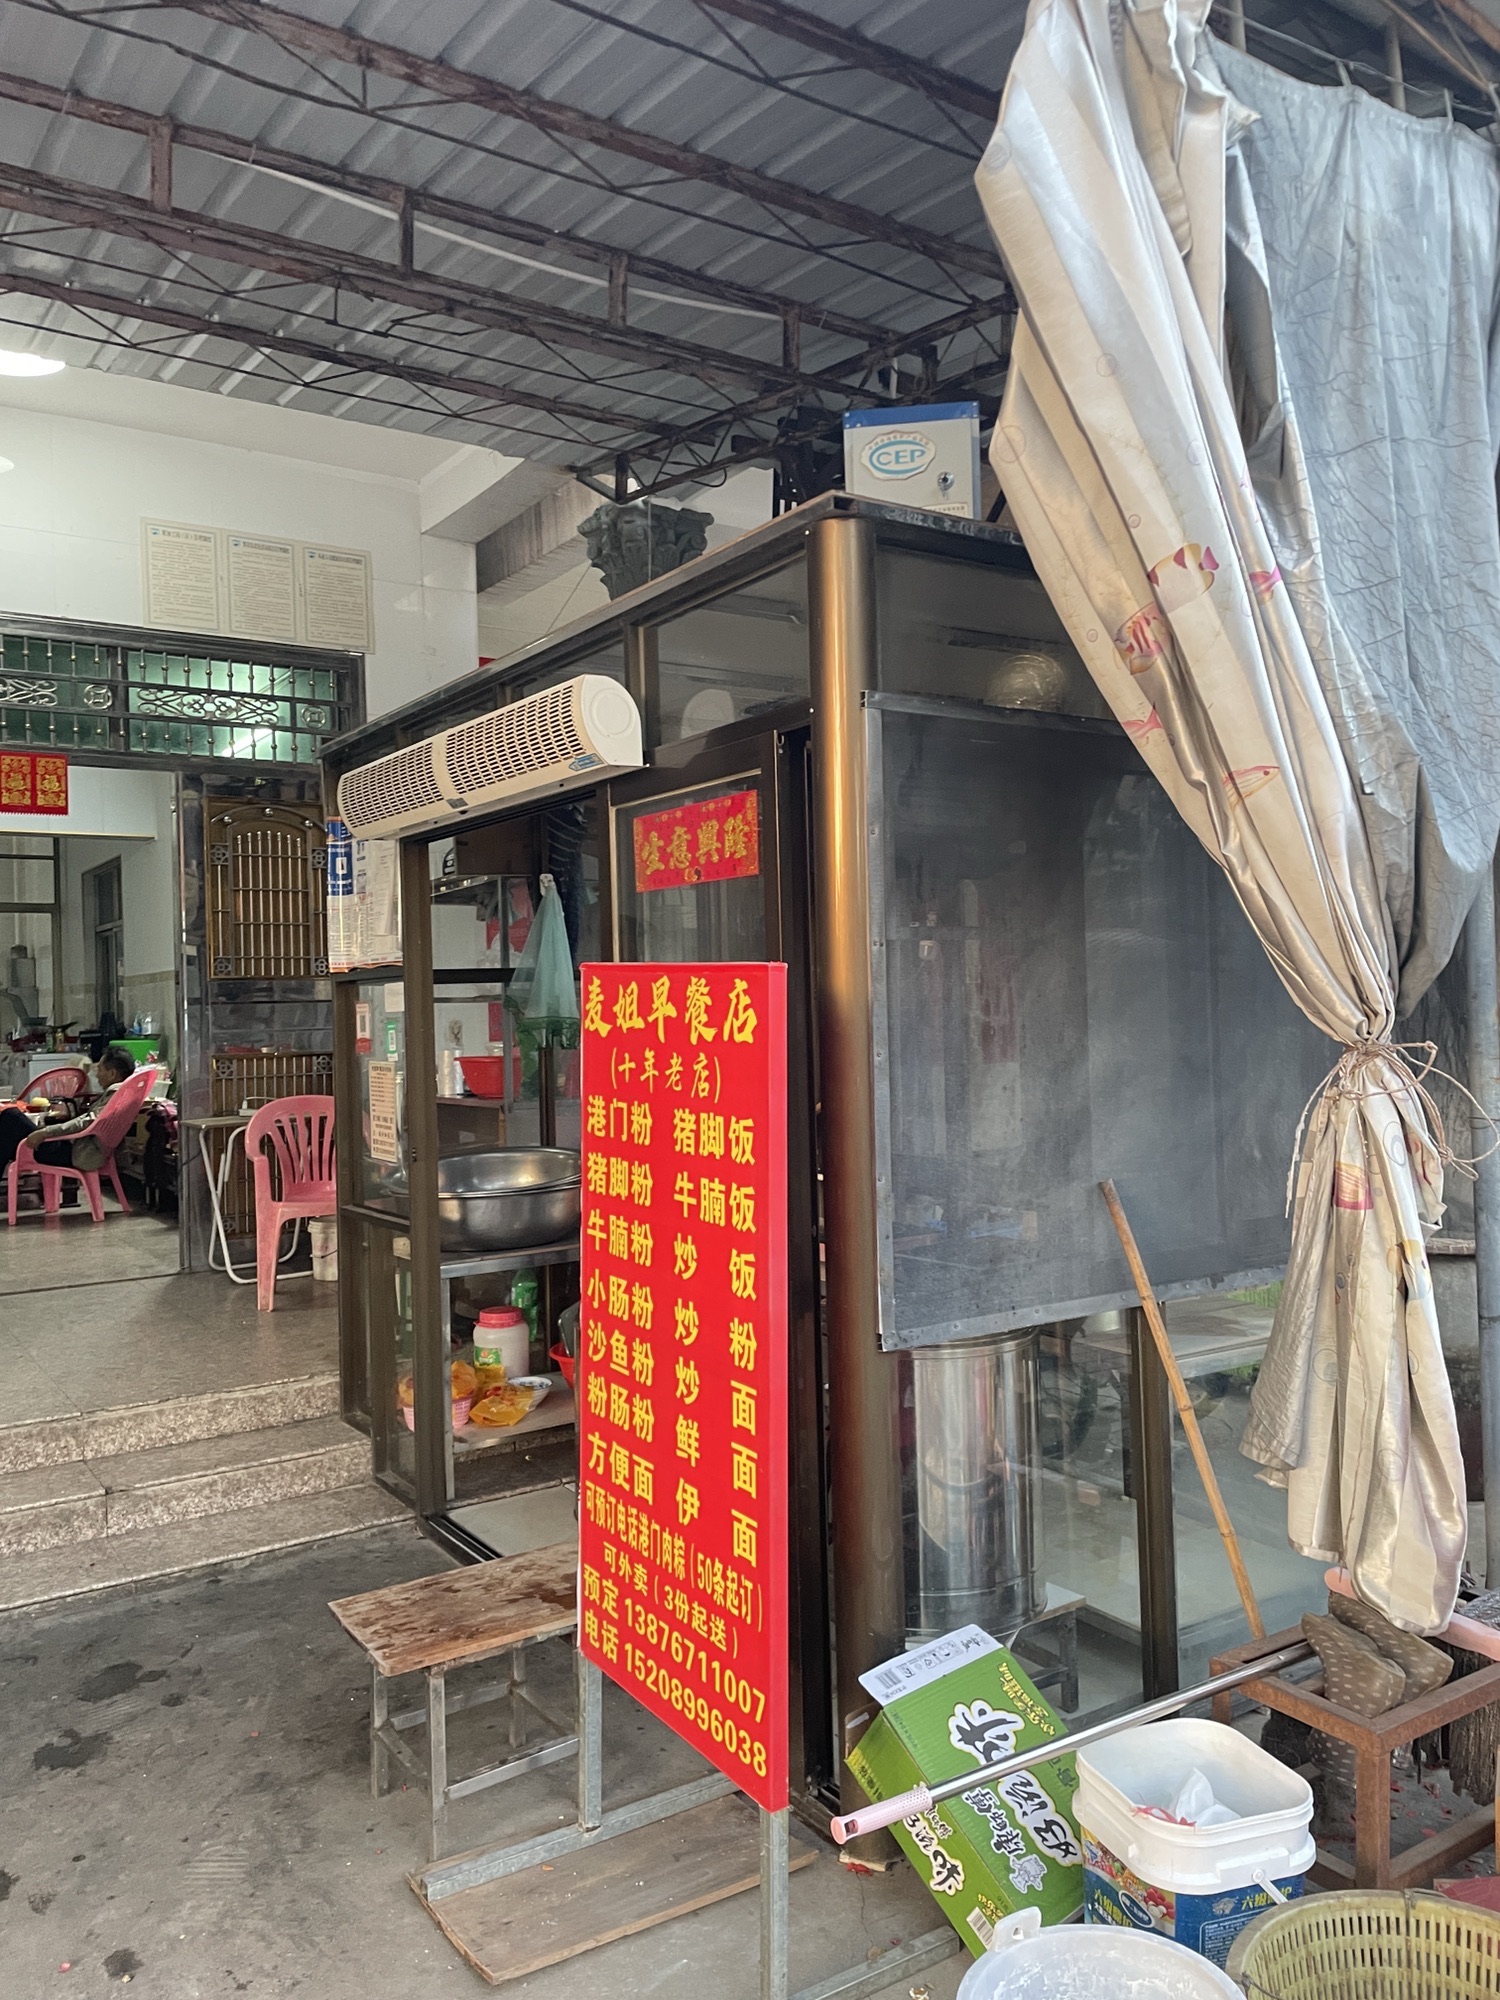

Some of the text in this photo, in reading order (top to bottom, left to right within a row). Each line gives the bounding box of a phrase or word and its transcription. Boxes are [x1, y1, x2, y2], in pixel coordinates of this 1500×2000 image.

[877, 449, 926, 466] CEP
[585, 975, 758, 1045] 麦姐早餐店
[587, 1095, 653, 1146] 港门粉
[673, 1108, 756, 1166] 猪脚饭
[587, 1152, 654, 1207] 猪脚粉
[673, 1171, 757, 1234] 牛腩饭
[586, 1208, 654, 1267] 牛腩粉
[586, 1268, 654, 1330] 小肠粉
[587, 1319, 655, 1387] 沙鱼粉
[587, 1371, 655, 1443] 粉肠粉
[586, 1431, 654, 1506] 方便面
[583, 1563, 766, 1723] 预定 13876711007
[584, 1609, 767, 1777] 电话 15208996038
